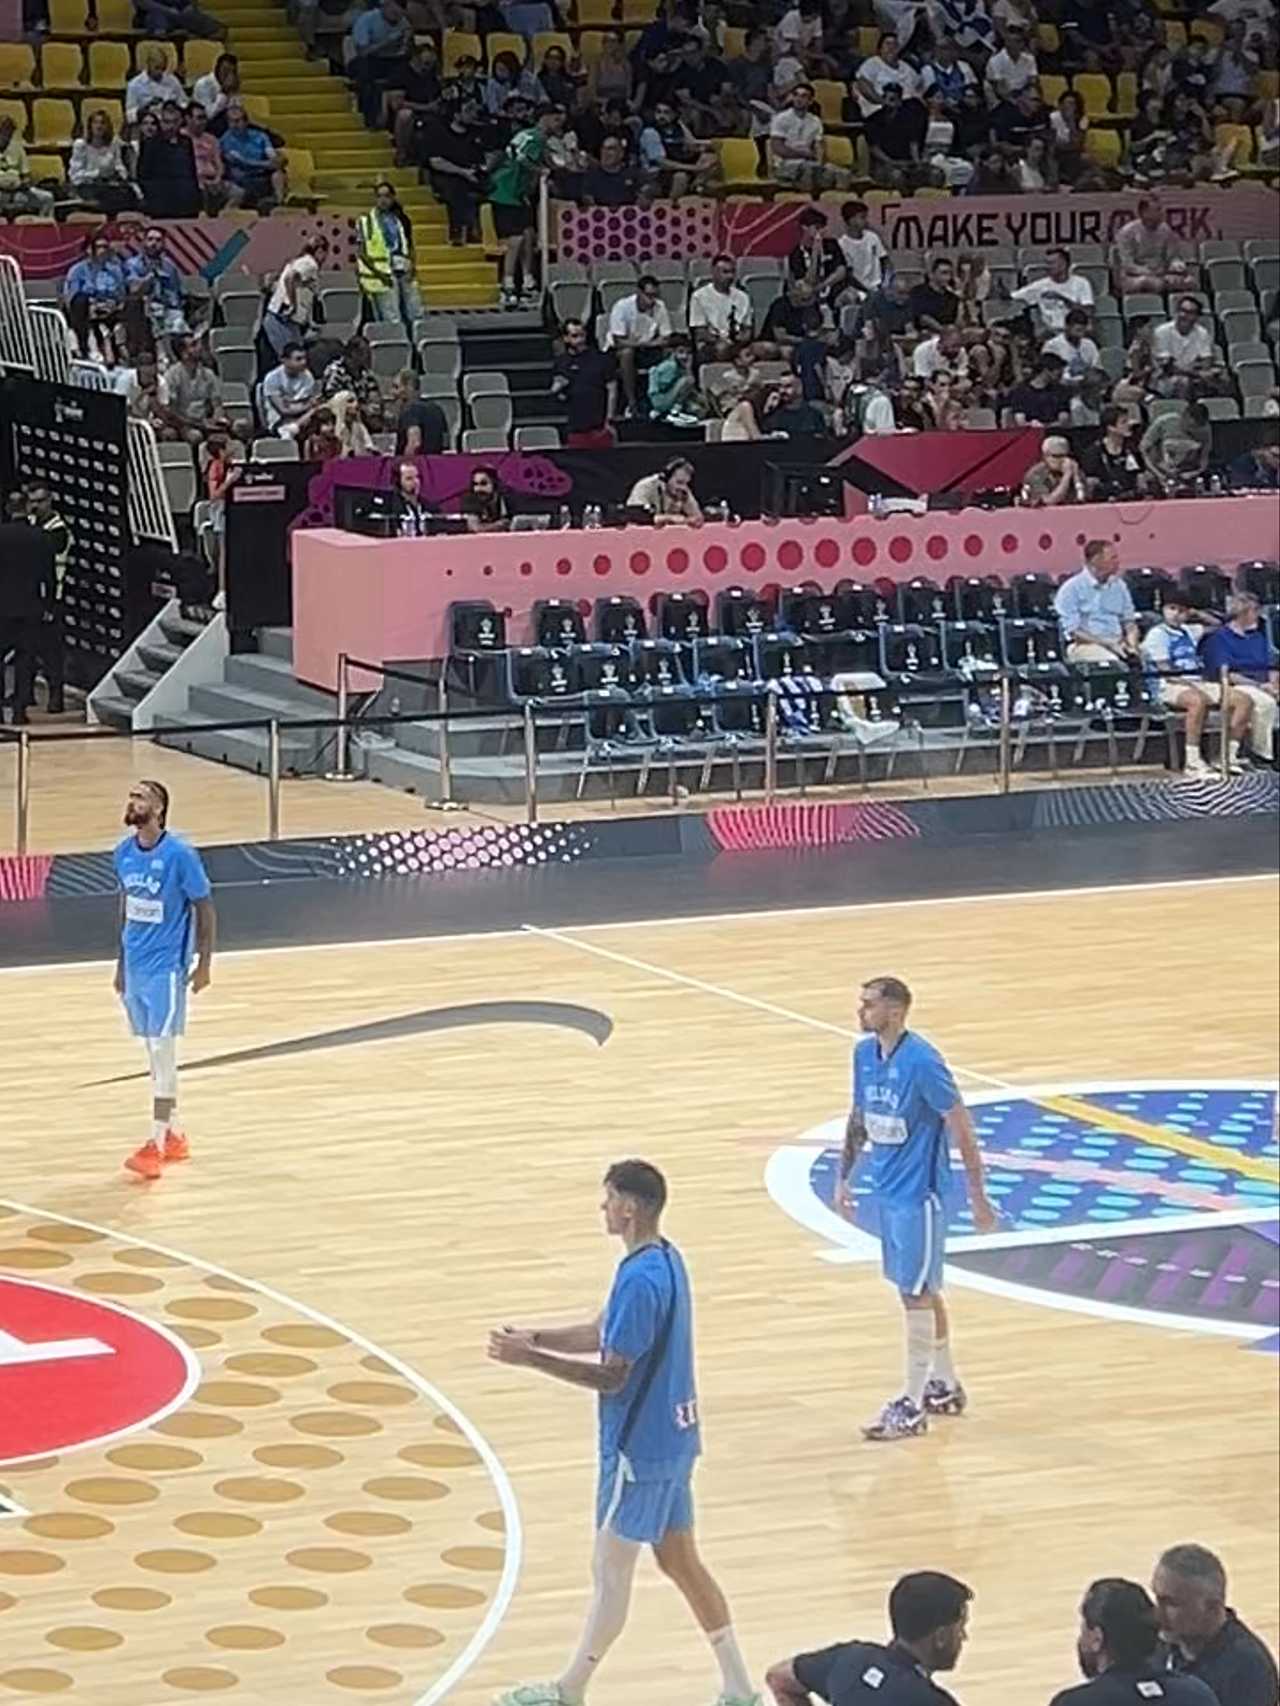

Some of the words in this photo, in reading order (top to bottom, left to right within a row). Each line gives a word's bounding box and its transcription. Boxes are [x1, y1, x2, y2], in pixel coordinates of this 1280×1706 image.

[891, 211, 1000, 250] MAKE
[1005, 210, 1101, 246] YOUR
[1107, 206, 1214, 242] MRK
